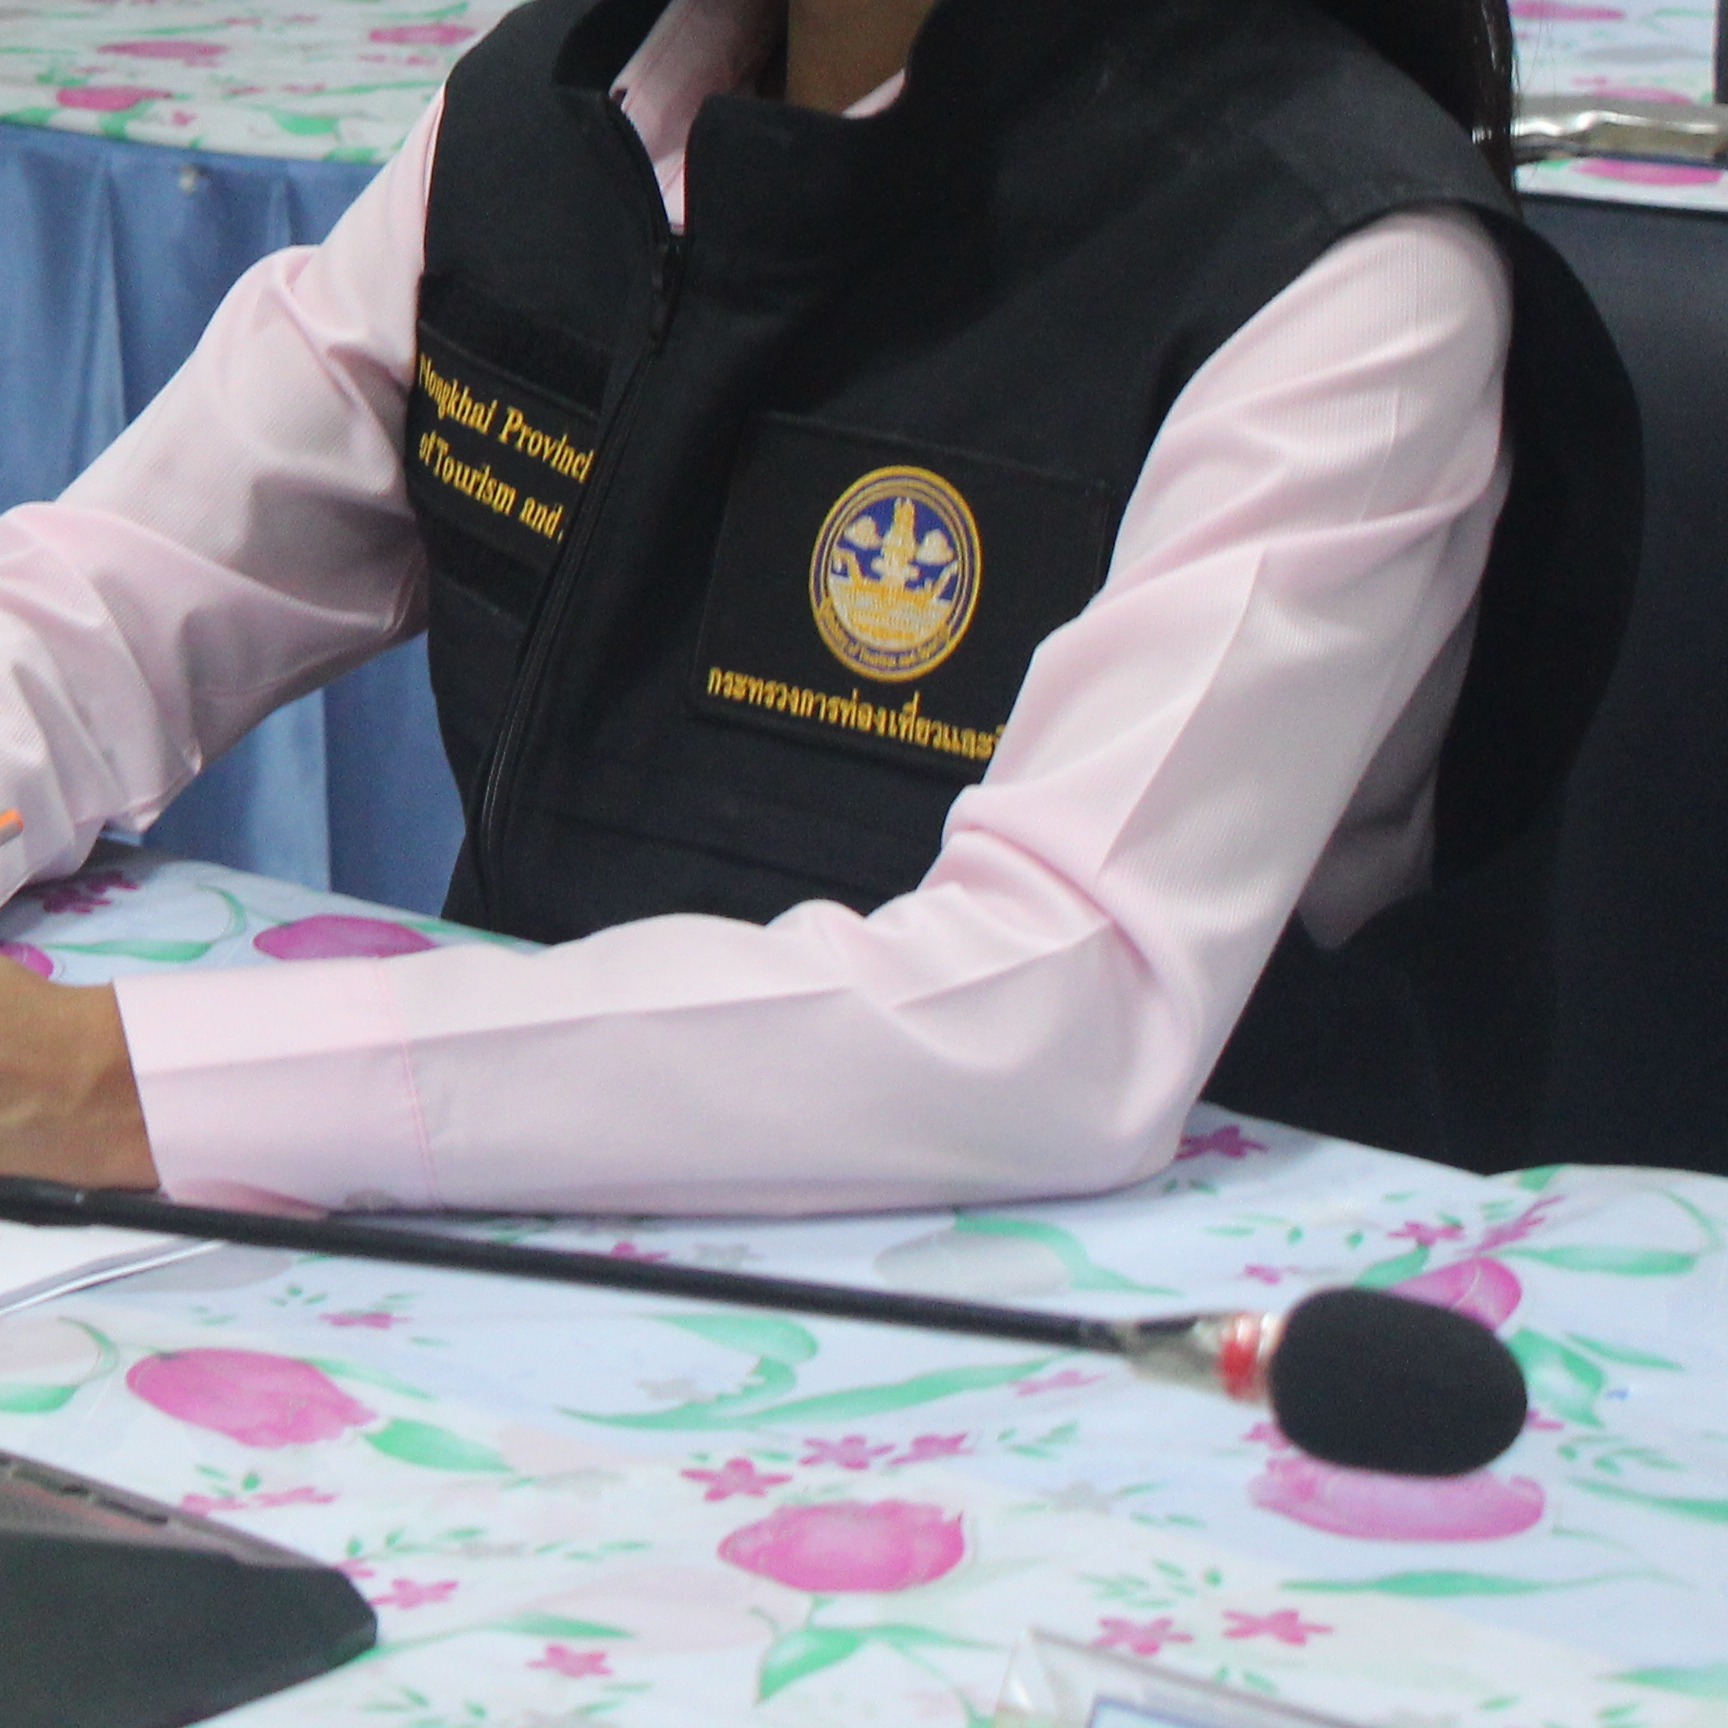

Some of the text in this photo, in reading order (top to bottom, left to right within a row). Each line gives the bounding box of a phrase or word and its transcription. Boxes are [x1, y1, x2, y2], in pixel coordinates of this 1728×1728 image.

[418, 352, 498, 435] Nongkhai
[419, 429, 564, 539] of Tourism and
[707, 666, 1004, 761] กระทรวงการท่องเที่ยวและ
